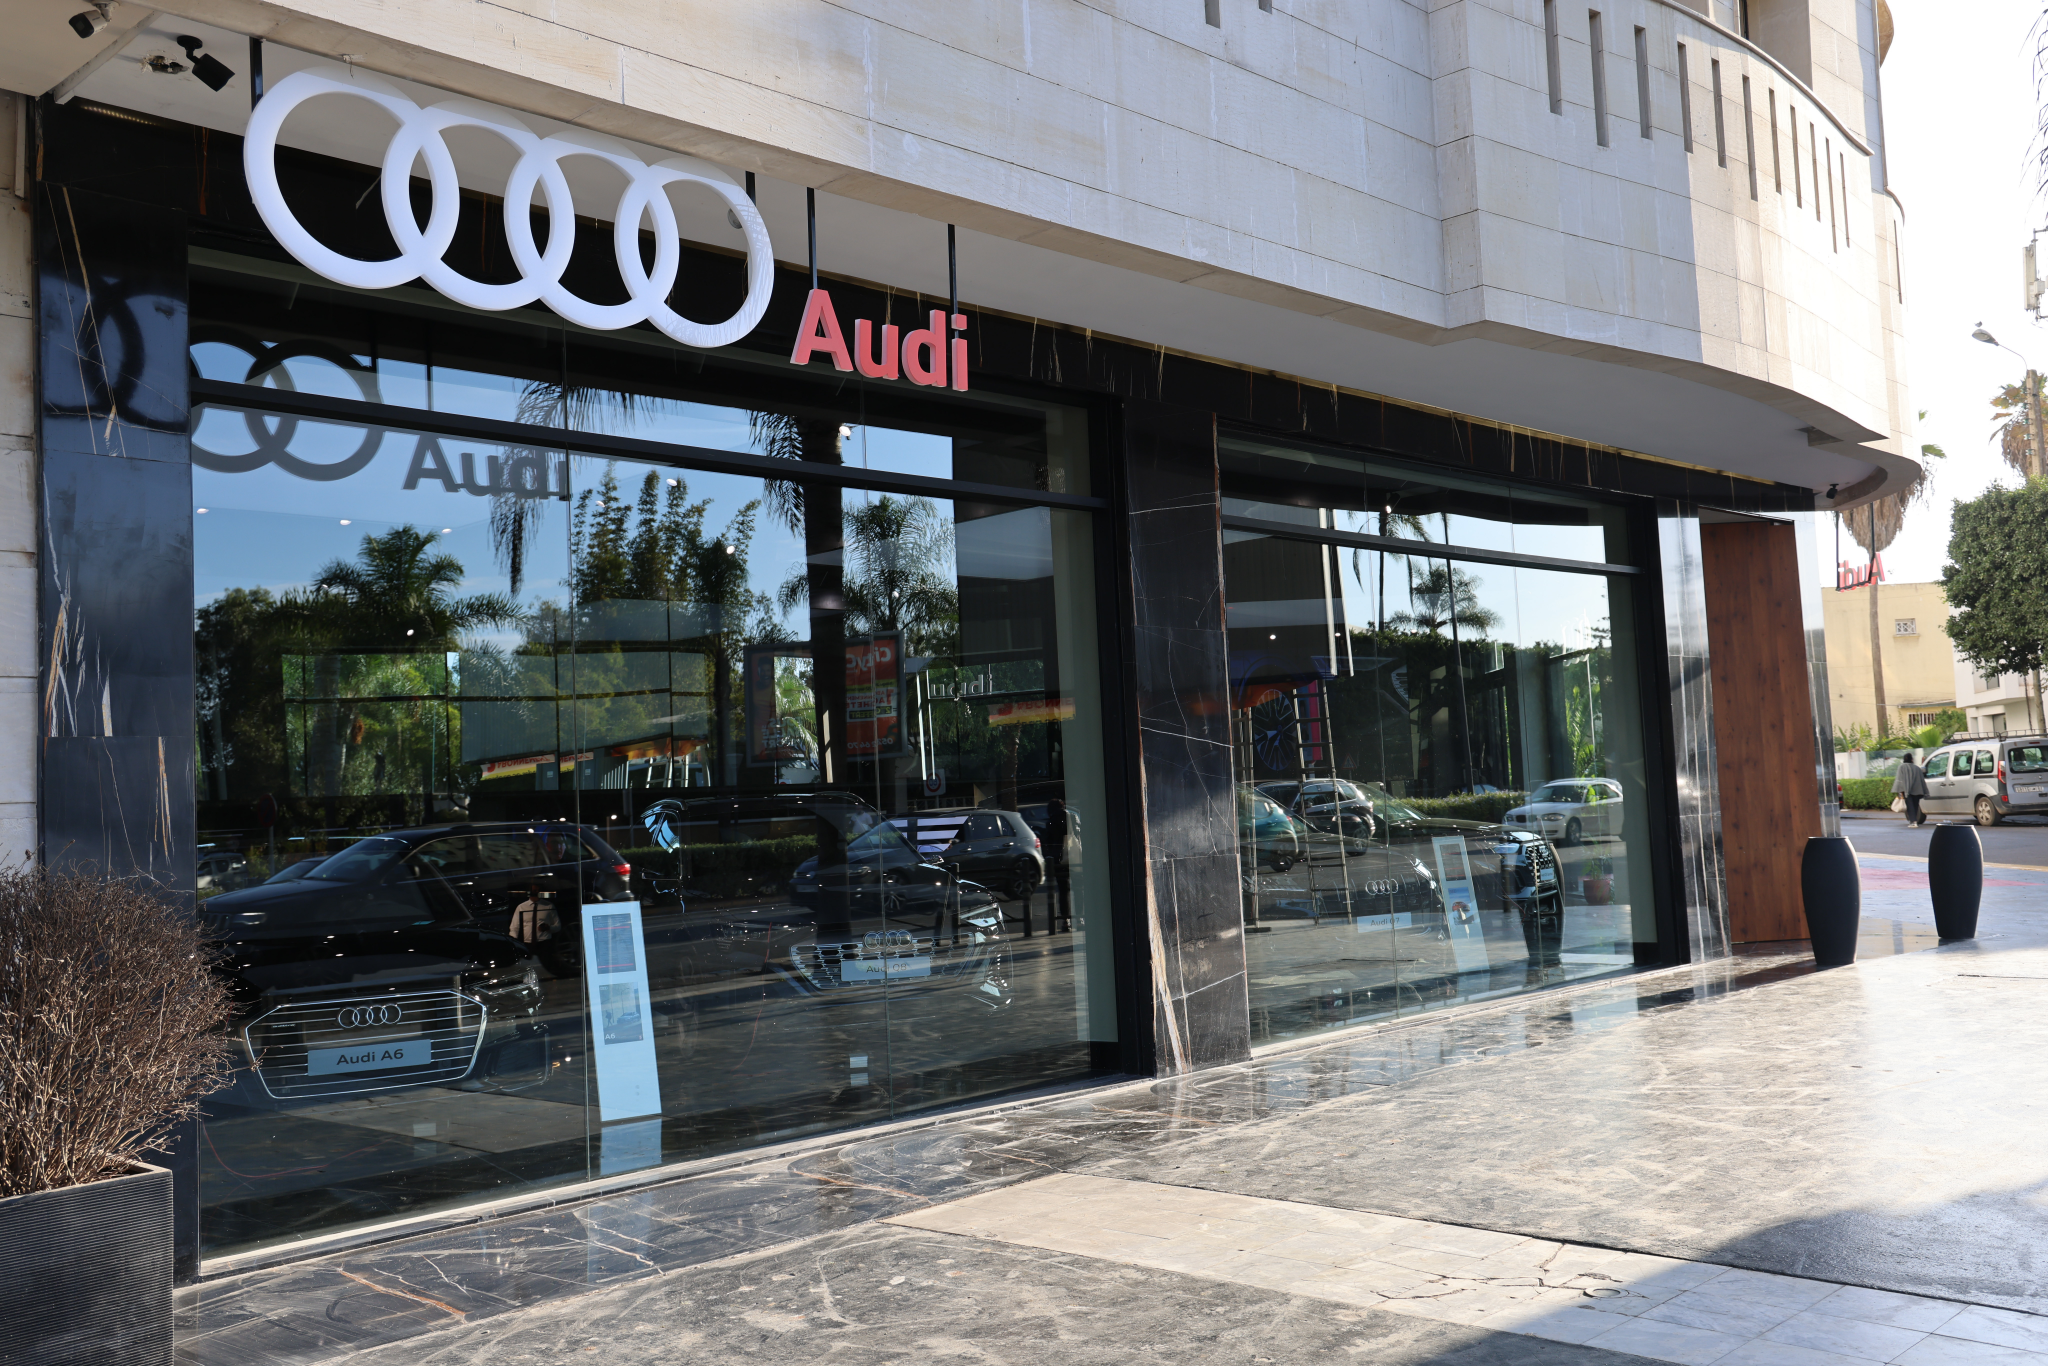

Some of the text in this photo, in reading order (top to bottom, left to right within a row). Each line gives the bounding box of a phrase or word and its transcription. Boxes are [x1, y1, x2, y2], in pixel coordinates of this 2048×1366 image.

[790, 288, 968, 392] Audi
[1370, 918, 1388, 927] Audi
[866, 963, 907, 974] Audi Q8
[604, 1032, 616, 1040] A6
[336, 1048, 404, 1066] Audi A6
